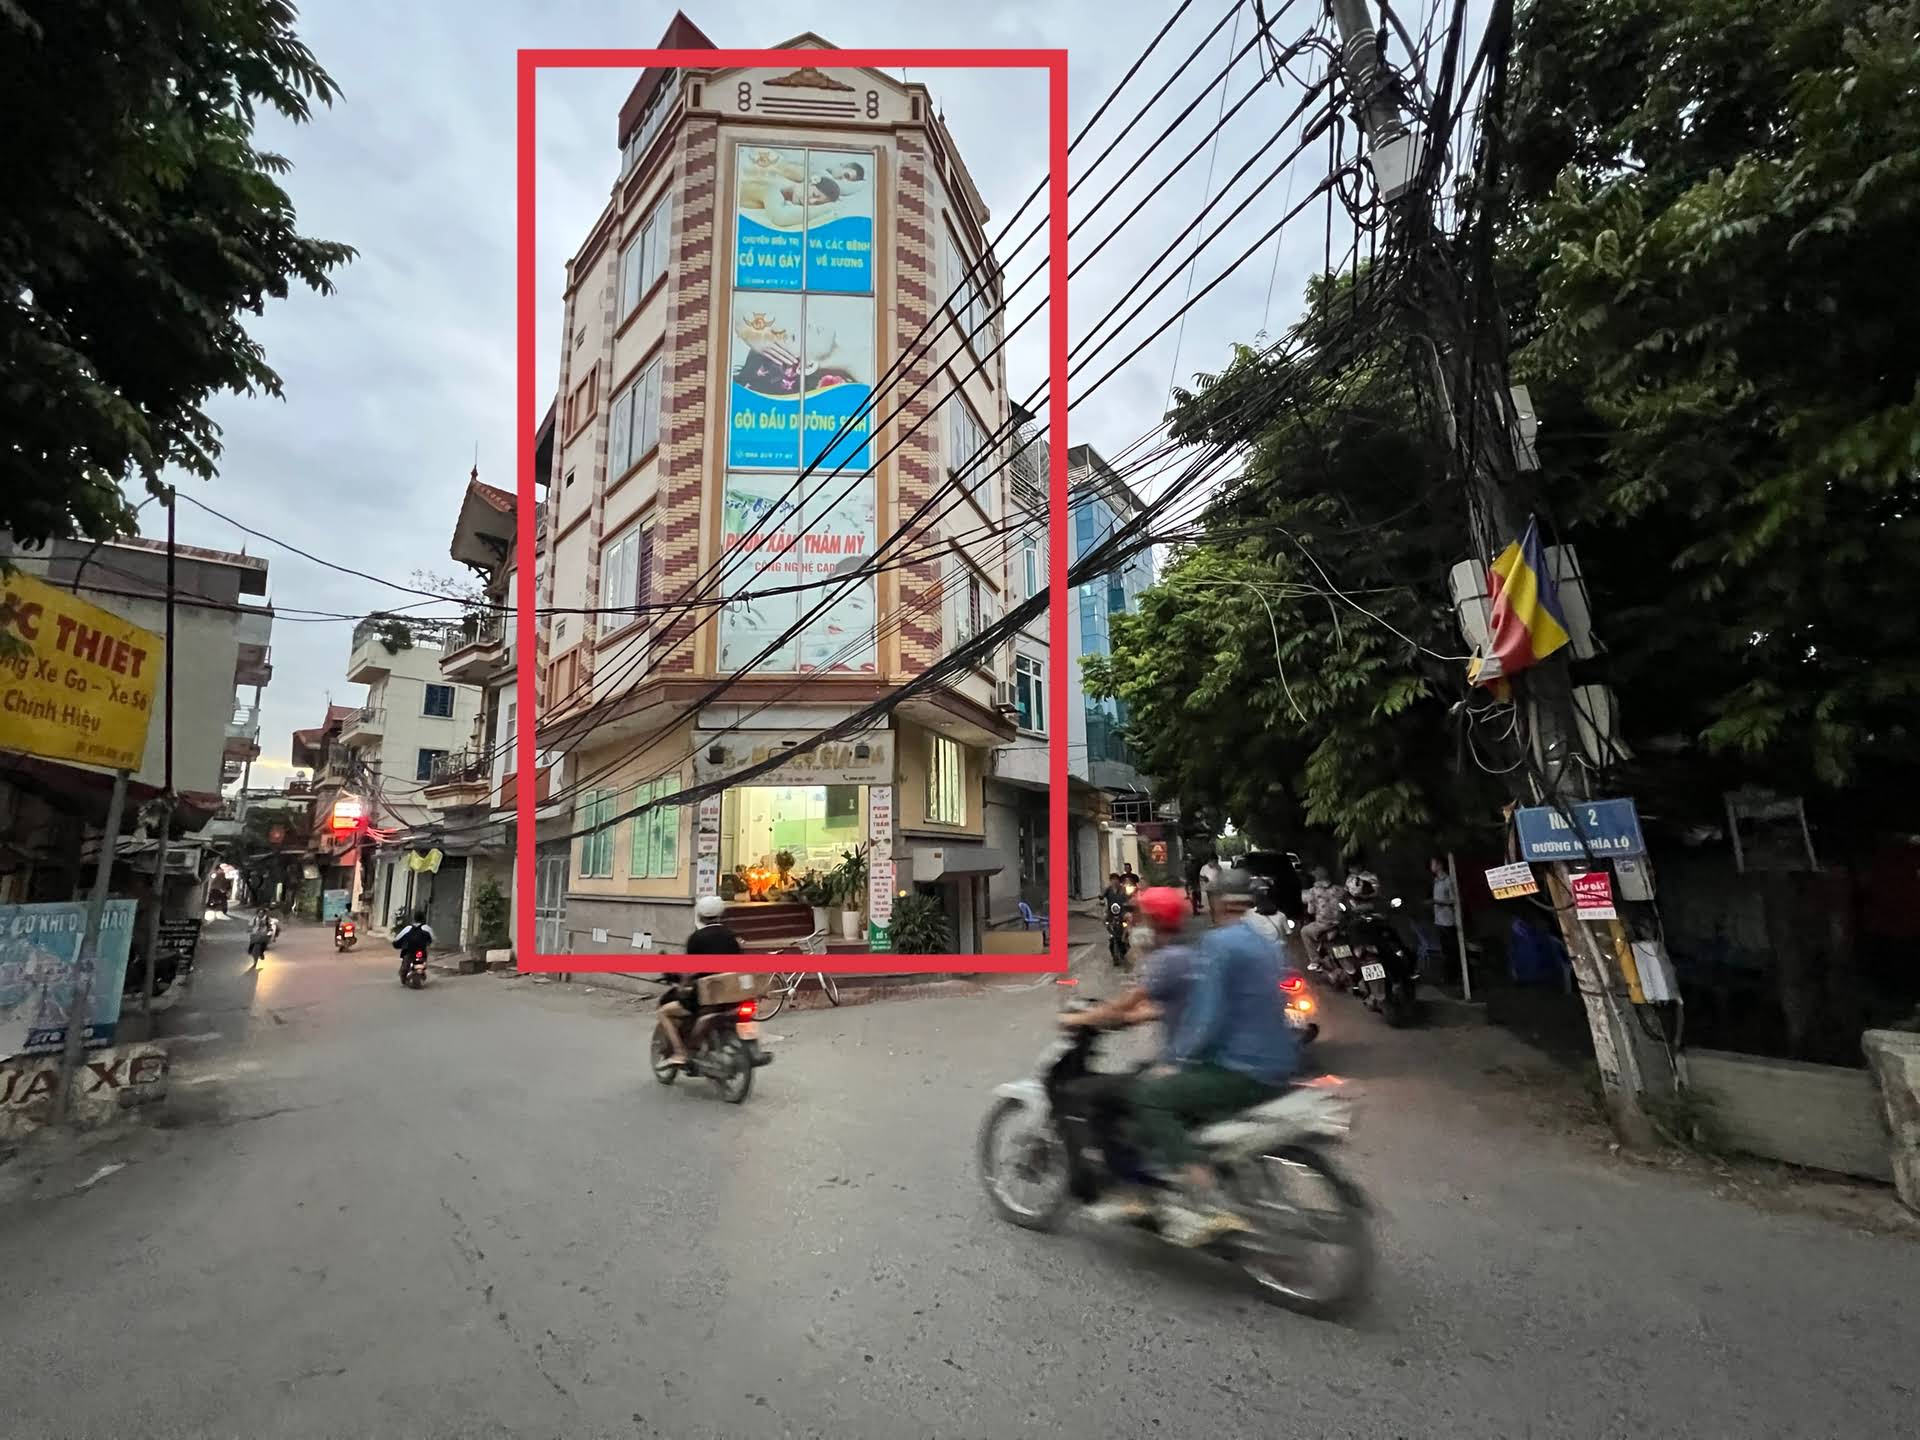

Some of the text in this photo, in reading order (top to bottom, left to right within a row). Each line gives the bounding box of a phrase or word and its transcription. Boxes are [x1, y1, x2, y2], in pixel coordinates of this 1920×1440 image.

[757, 254, 776, 267] VAI
[778, 251, 801, 269] GÁY
[56, 613, 147, 679] THIẾT
[34, 656, 59, 683] Xe
[109, 678, 128, 705] Xe
[1587, 808, 1599, 827] 2
